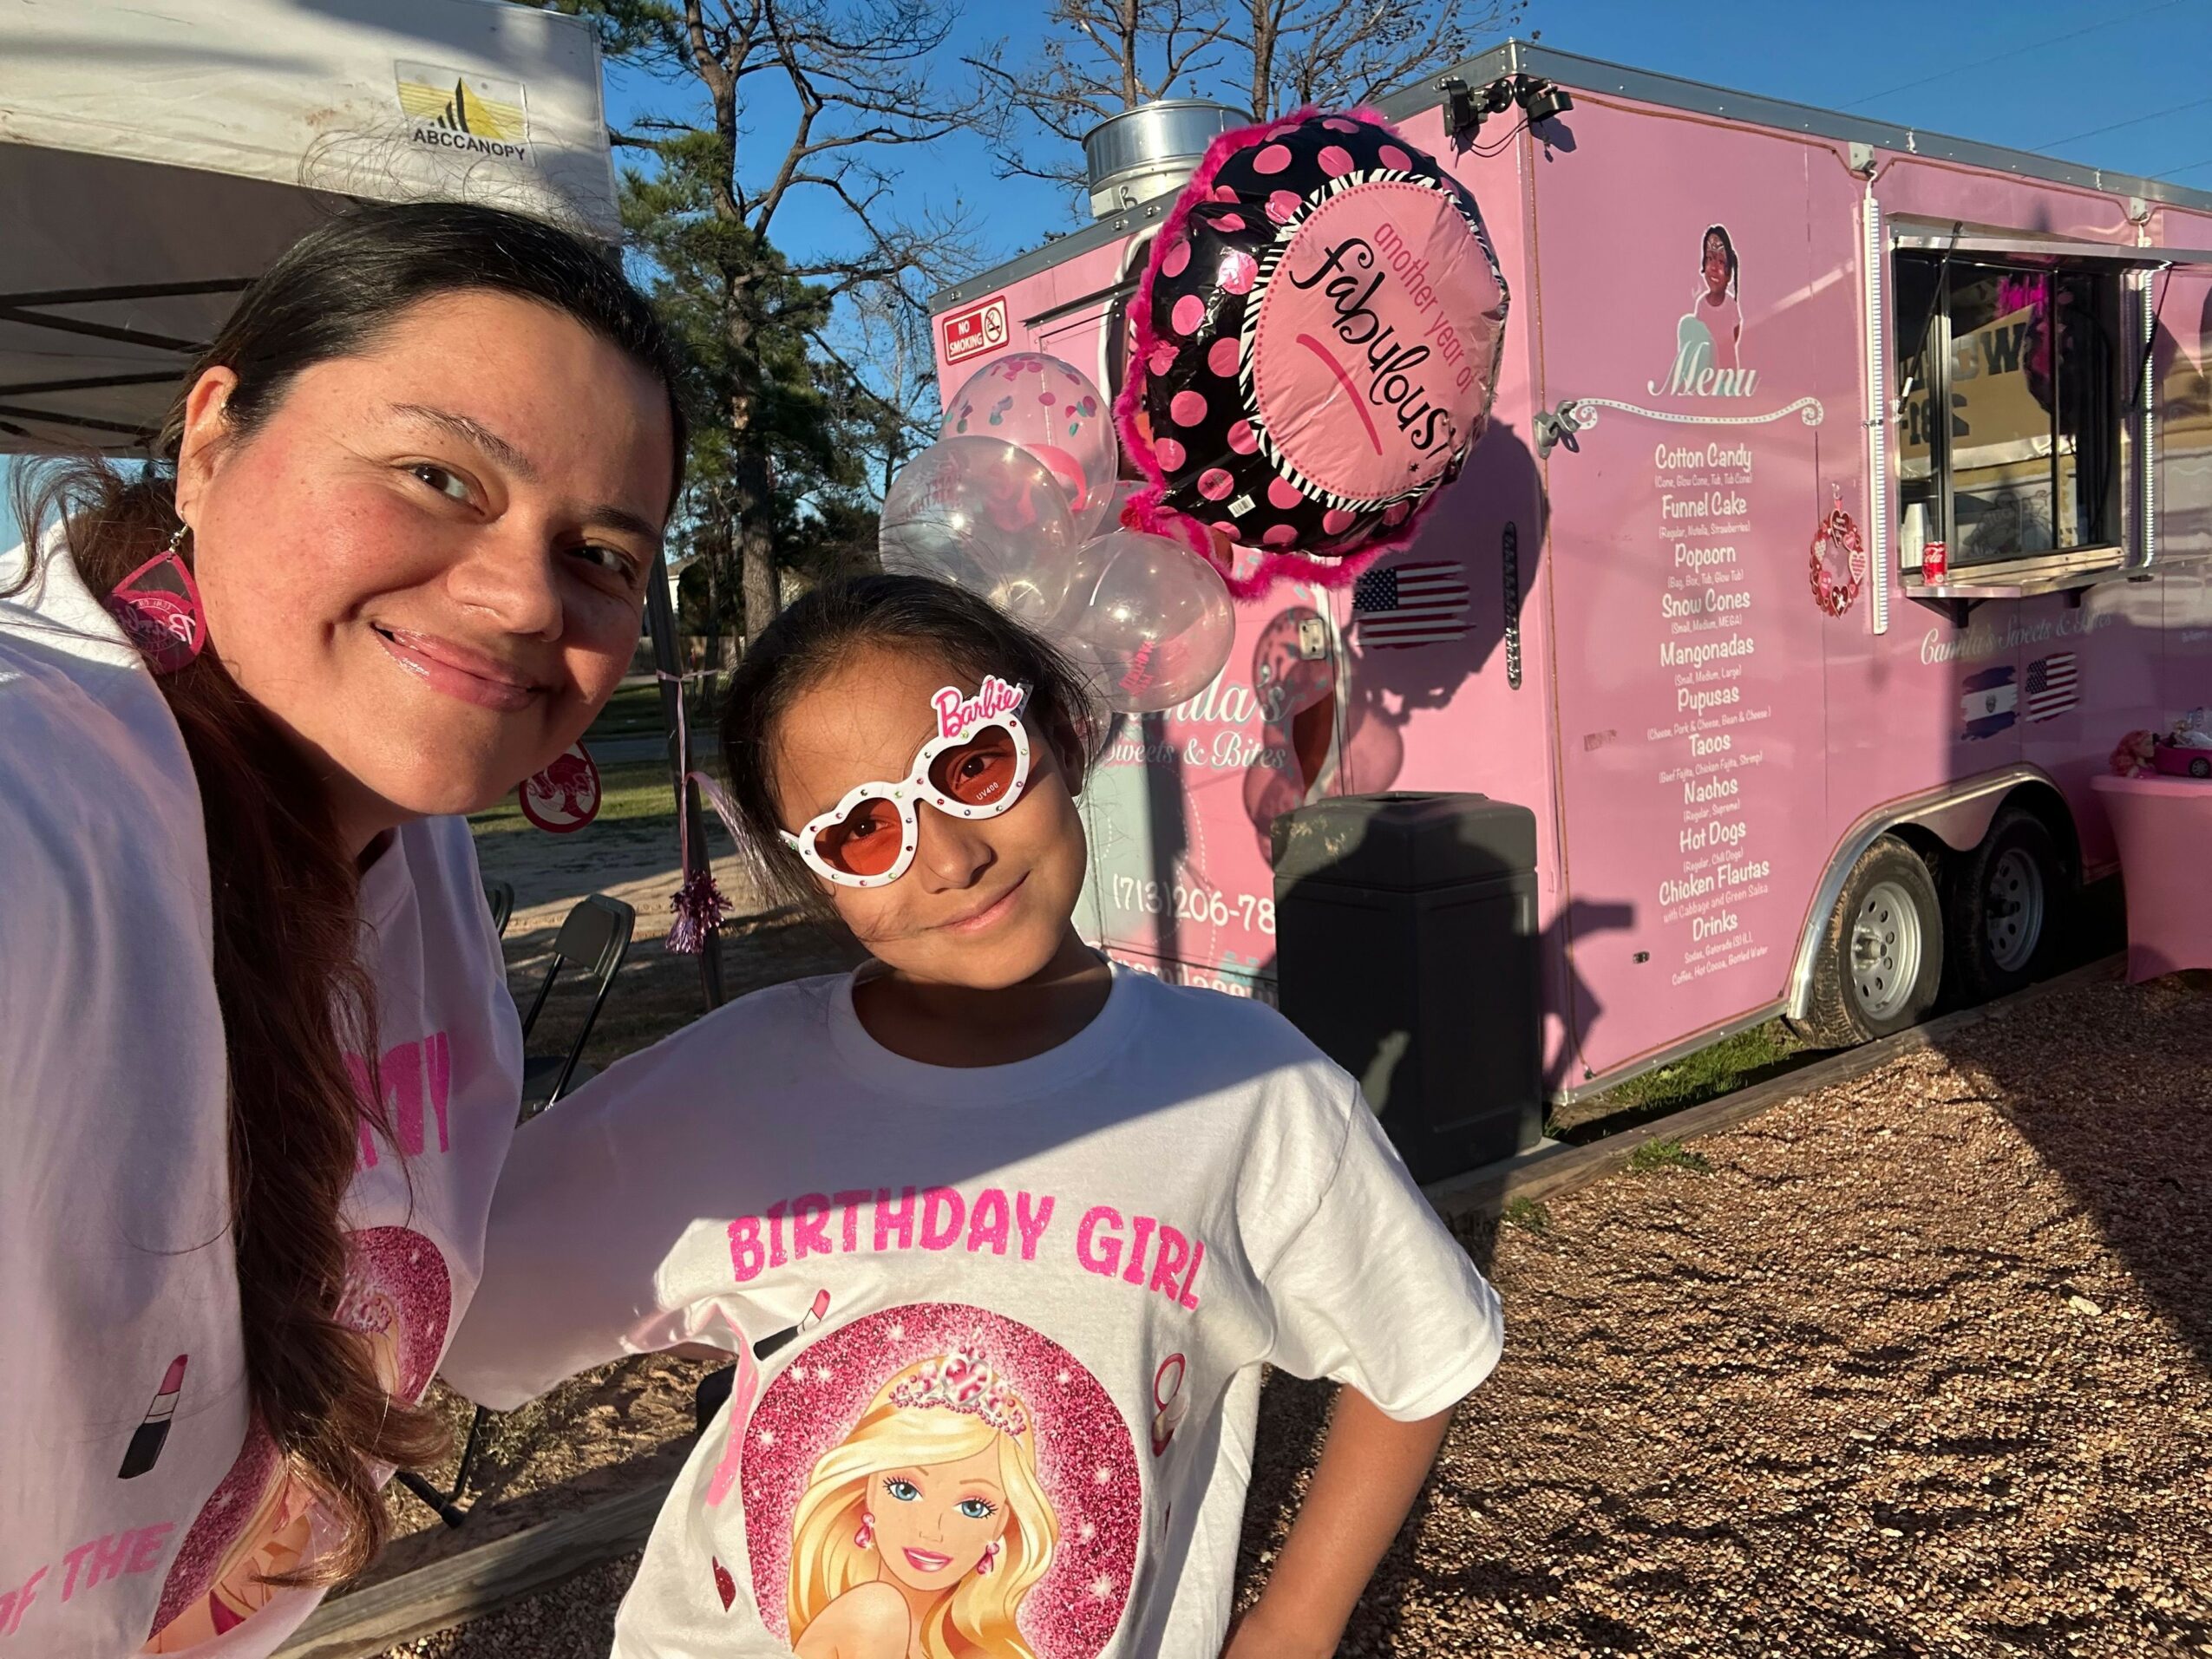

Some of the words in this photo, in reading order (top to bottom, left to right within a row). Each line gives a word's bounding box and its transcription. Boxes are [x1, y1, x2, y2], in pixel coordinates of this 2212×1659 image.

[413, 128, 525, 160] ABCCANOPY
[1374, 221, 1439, 314] another
[1423, 310, 1465, 368] year
[949, 332, 983, 355] SMOKING
[958, 320, 970, 336] NO
[1647, 342, 1762, 397] Menu
[1655, 443, 1705, 469] Cotton
[1707, 441, 1752, 473] Candy
[1662, 492, 1708, 519] Funnel
[1711, 491, 1747, 516] Cake
[1675, 543, 1736, 573] Popcorn
[1662, 593, 1702, 618] Snow
[1705, 588, 1751, 612] Cones
[1660, 632, 1754, 669] Mangonadas
[935, 679, 1022, 738] Barbie
[1678, 686, 1739, 717] Pupusas
[1183, 738, 1209, 766] &
[1211, 729, 1286, 769] Bites
[1688, 733, 1731, 757] Tacos
[976, 781, 999, 800] UV400
[1685, 775, 1738, 805] Nachos
[1679, 828, 1706, 853] Hot
[1709, 820, 1746, 846] Dogs
[1659, 873, 1714, 905] Chicken
[1718, 860, 1770, 888] Flautas
[1664, 907, 1679, 923] with
[1679, 901, 1710, 918] Cabbage
[1711, 893, 1724, 908] and
[1725, 891, 1746, 904] Green
[1748, 883, 1768, 898] Salsa
[1692, 909, 1738, 942] Drinks
[726, 1185, 1055, 1282] BIRTHDAY
[1077, 1205, 1205, 1311] GIRL
[62, 1522, 177, 1603] THE
